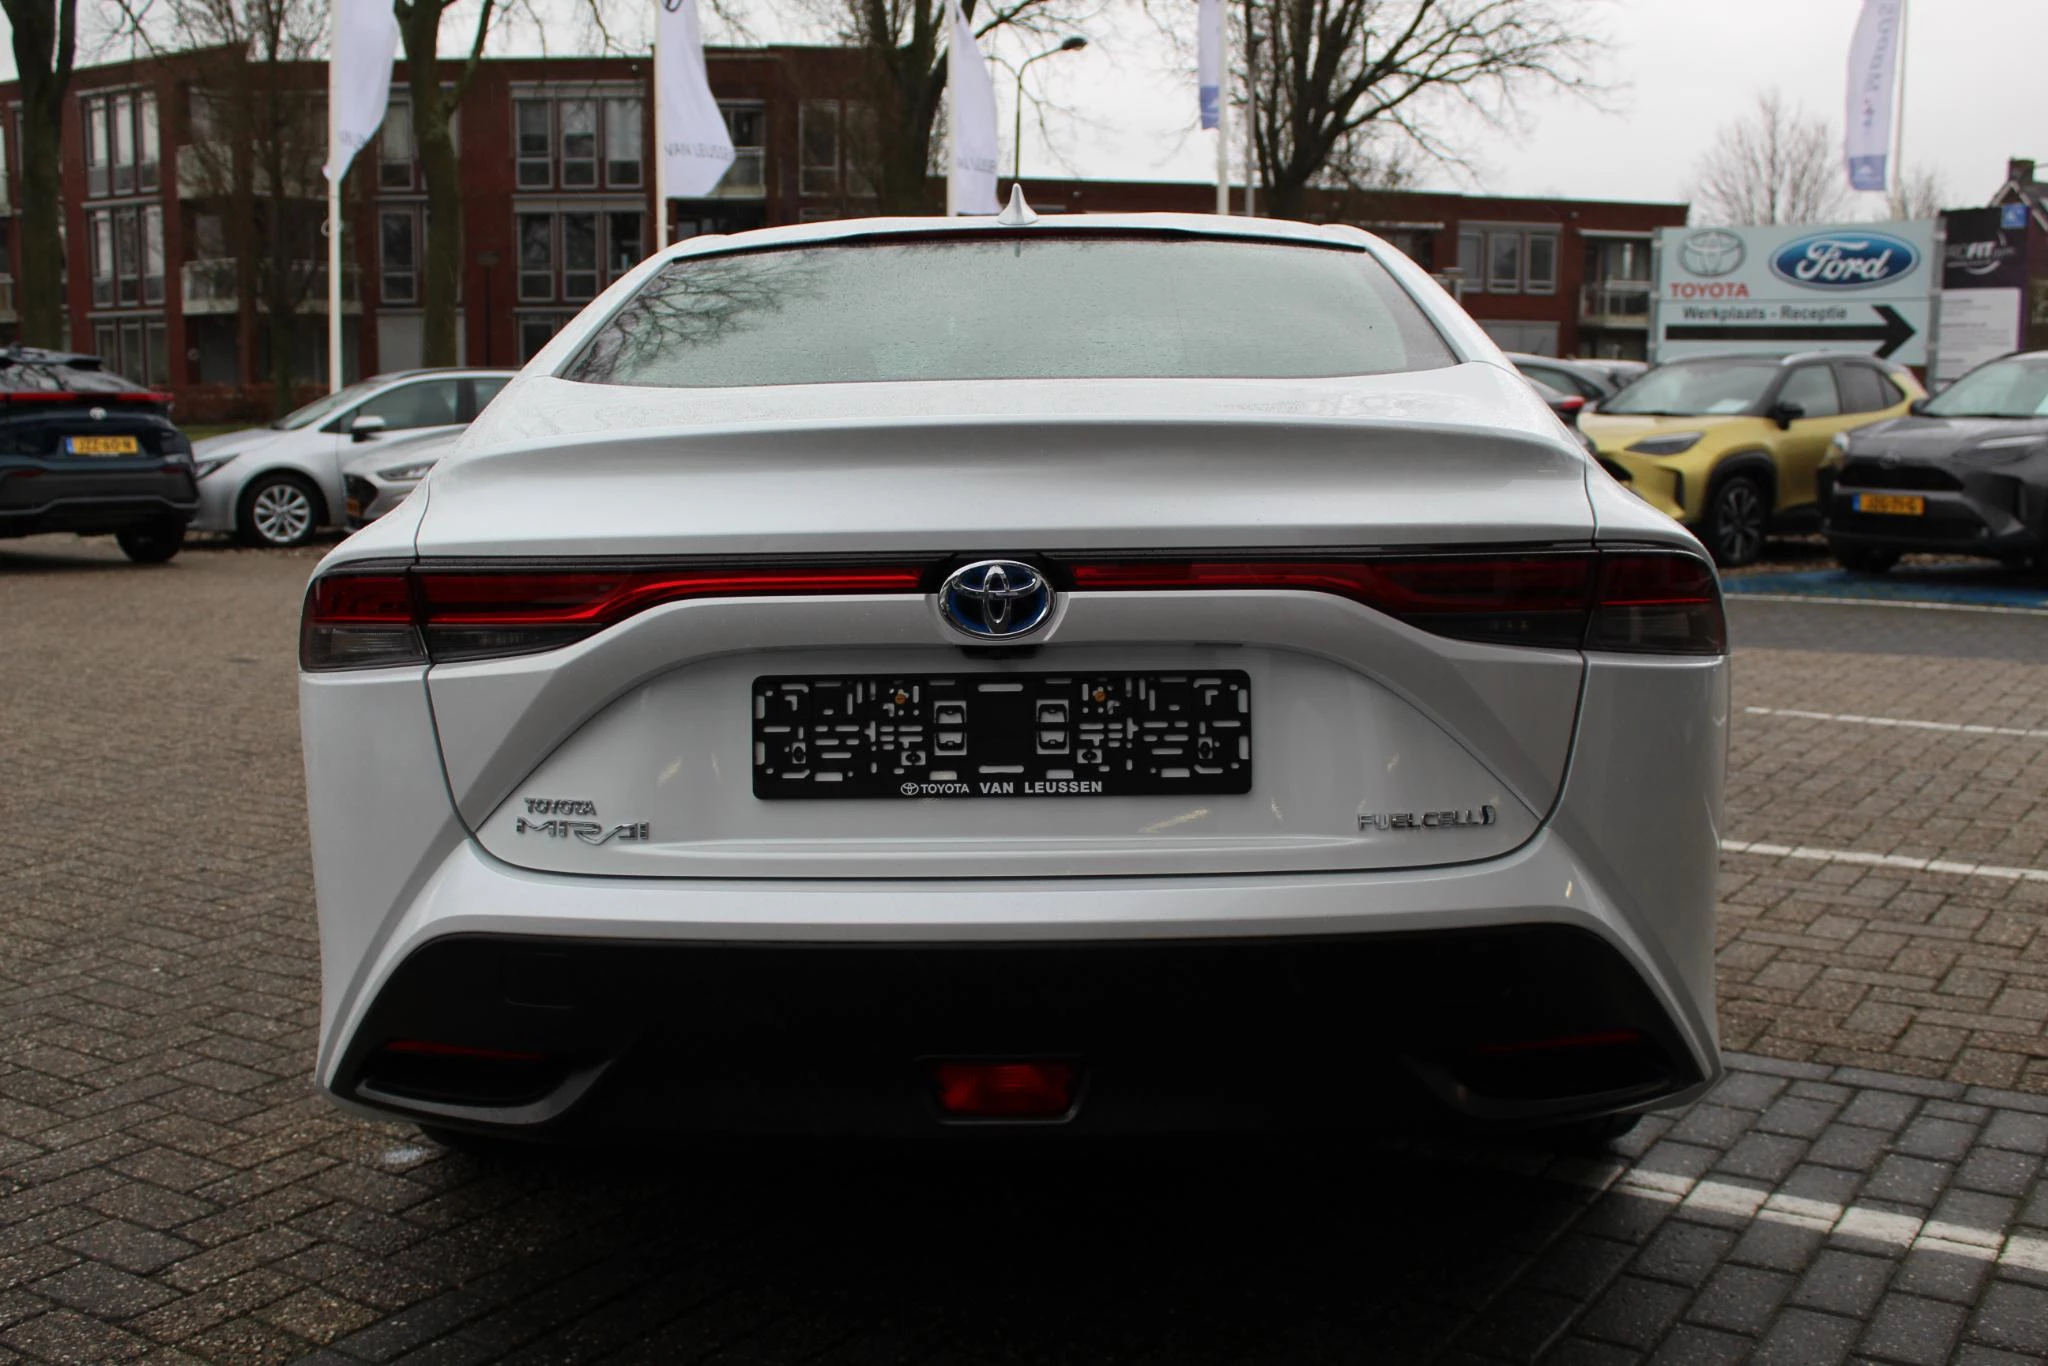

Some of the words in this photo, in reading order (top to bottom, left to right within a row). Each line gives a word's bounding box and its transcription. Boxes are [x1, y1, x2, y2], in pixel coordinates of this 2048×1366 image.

[1795, 240, 1892, 280] Ford
[1669, 282, 1750, 299] TOYOTA
[1683, 305, 1766, 321] Werkplaats
[1780, 305, 1848, 321] Receptie
[921, 783, 970, 794] TOYOTA
[979, 782, 1014, 794] VAN
[1024, 781, 1103, 793] LEUSSEN
[525, 798, 597, 816] TOYOTA
[516, 816, 650, 845] MIRAI
